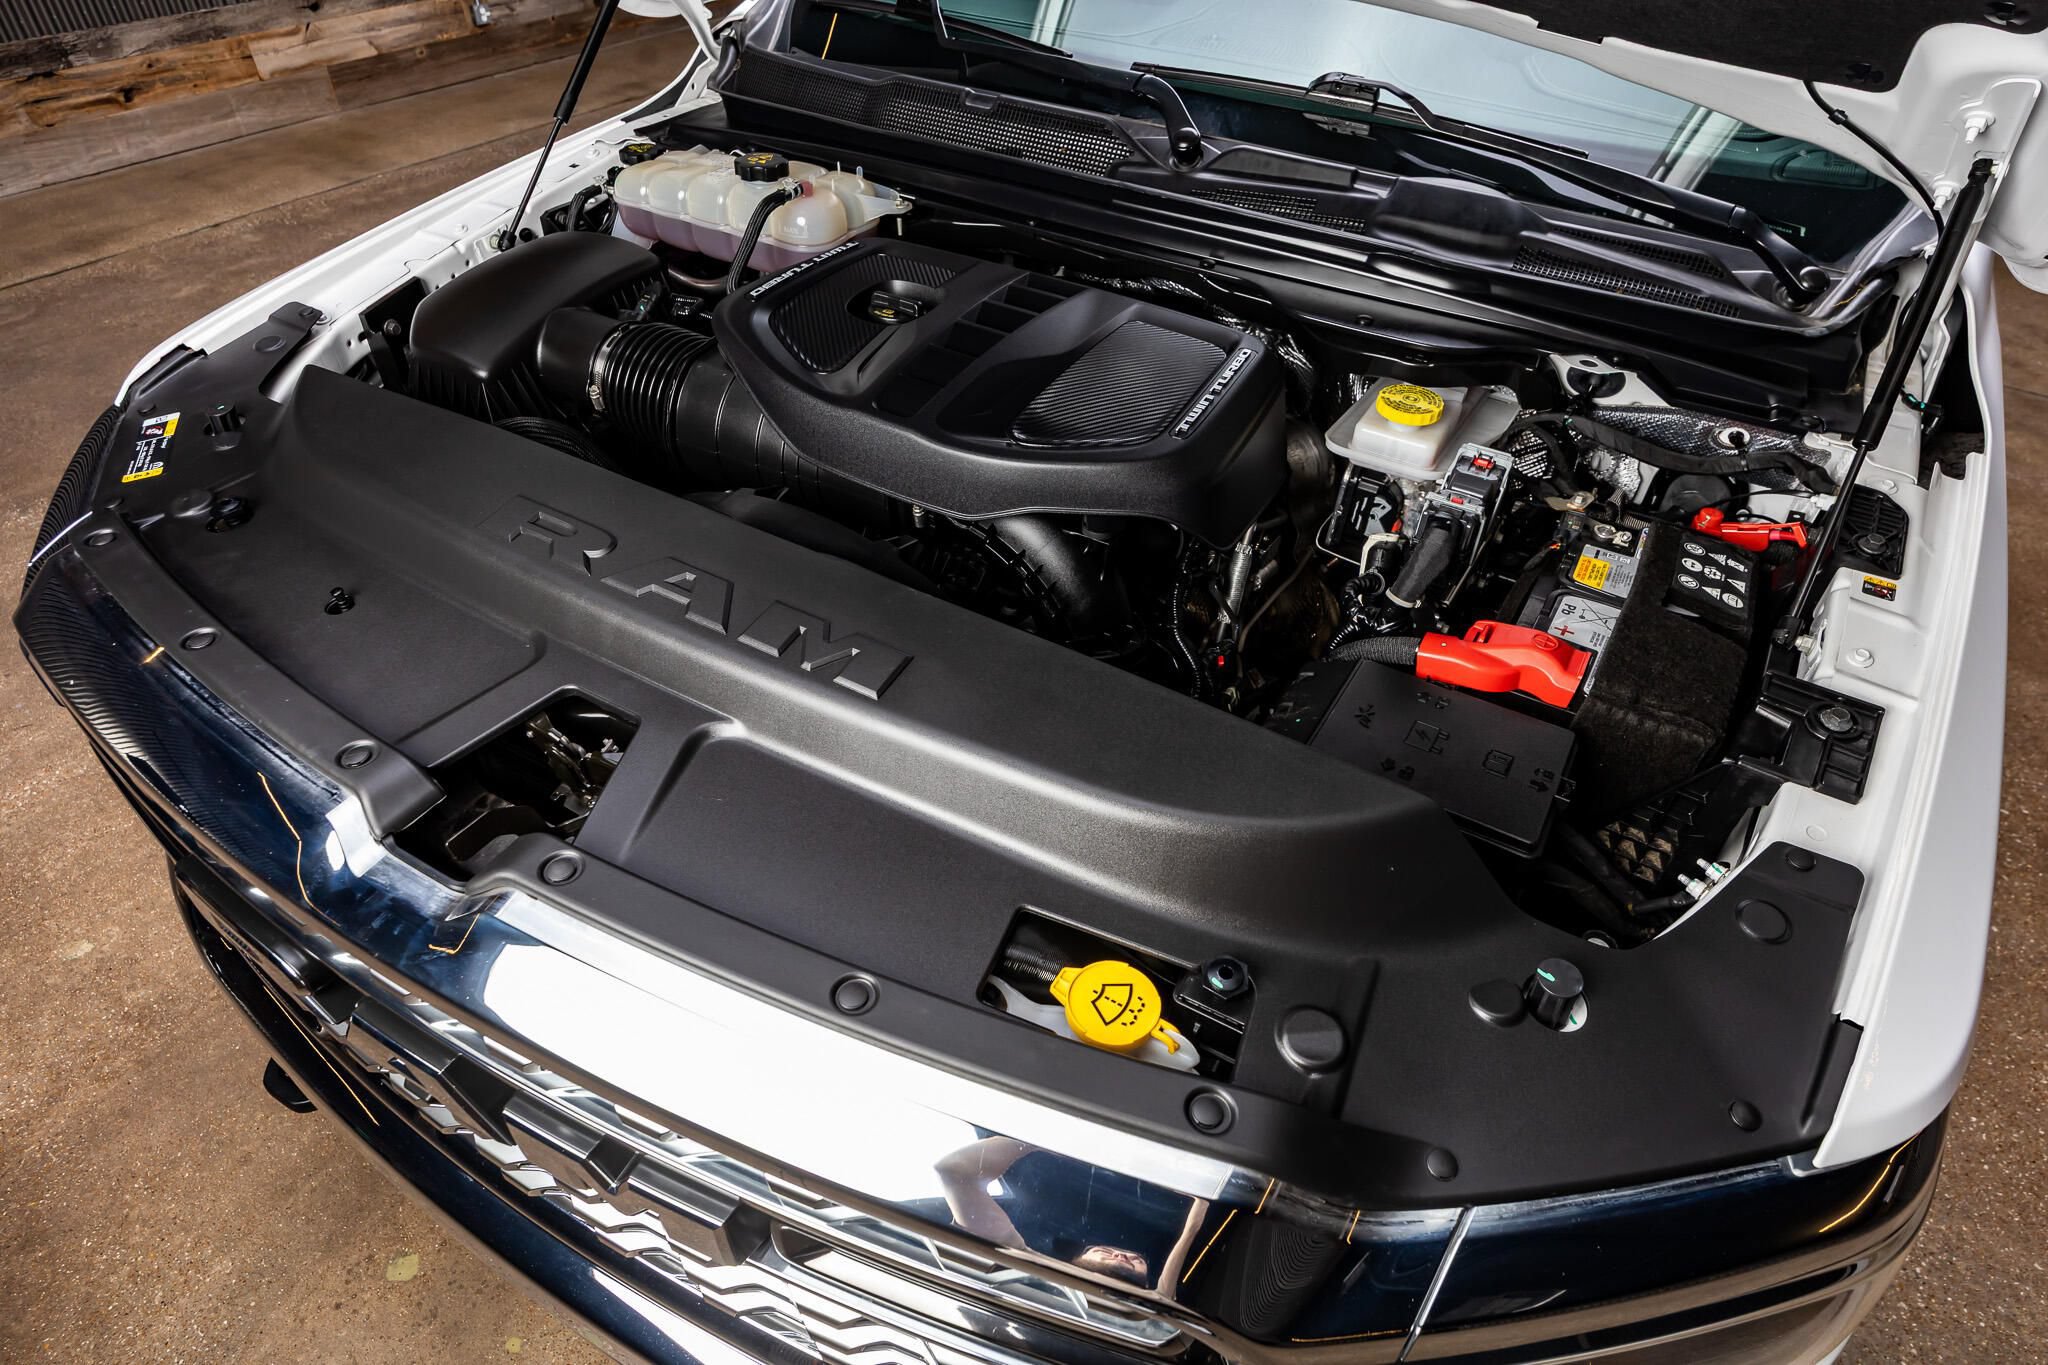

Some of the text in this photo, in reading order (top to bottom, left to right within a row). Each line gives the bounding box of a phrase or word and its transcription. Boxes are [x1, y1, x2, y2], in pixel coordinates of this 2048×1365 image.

[749, 240, 859, 297] TWIN TURBO
[1175, 348, 1252, 434] TWIN TURBO
[476, 494, 914, 700] RAM
[1561, 602, 1577, 616] Pb
